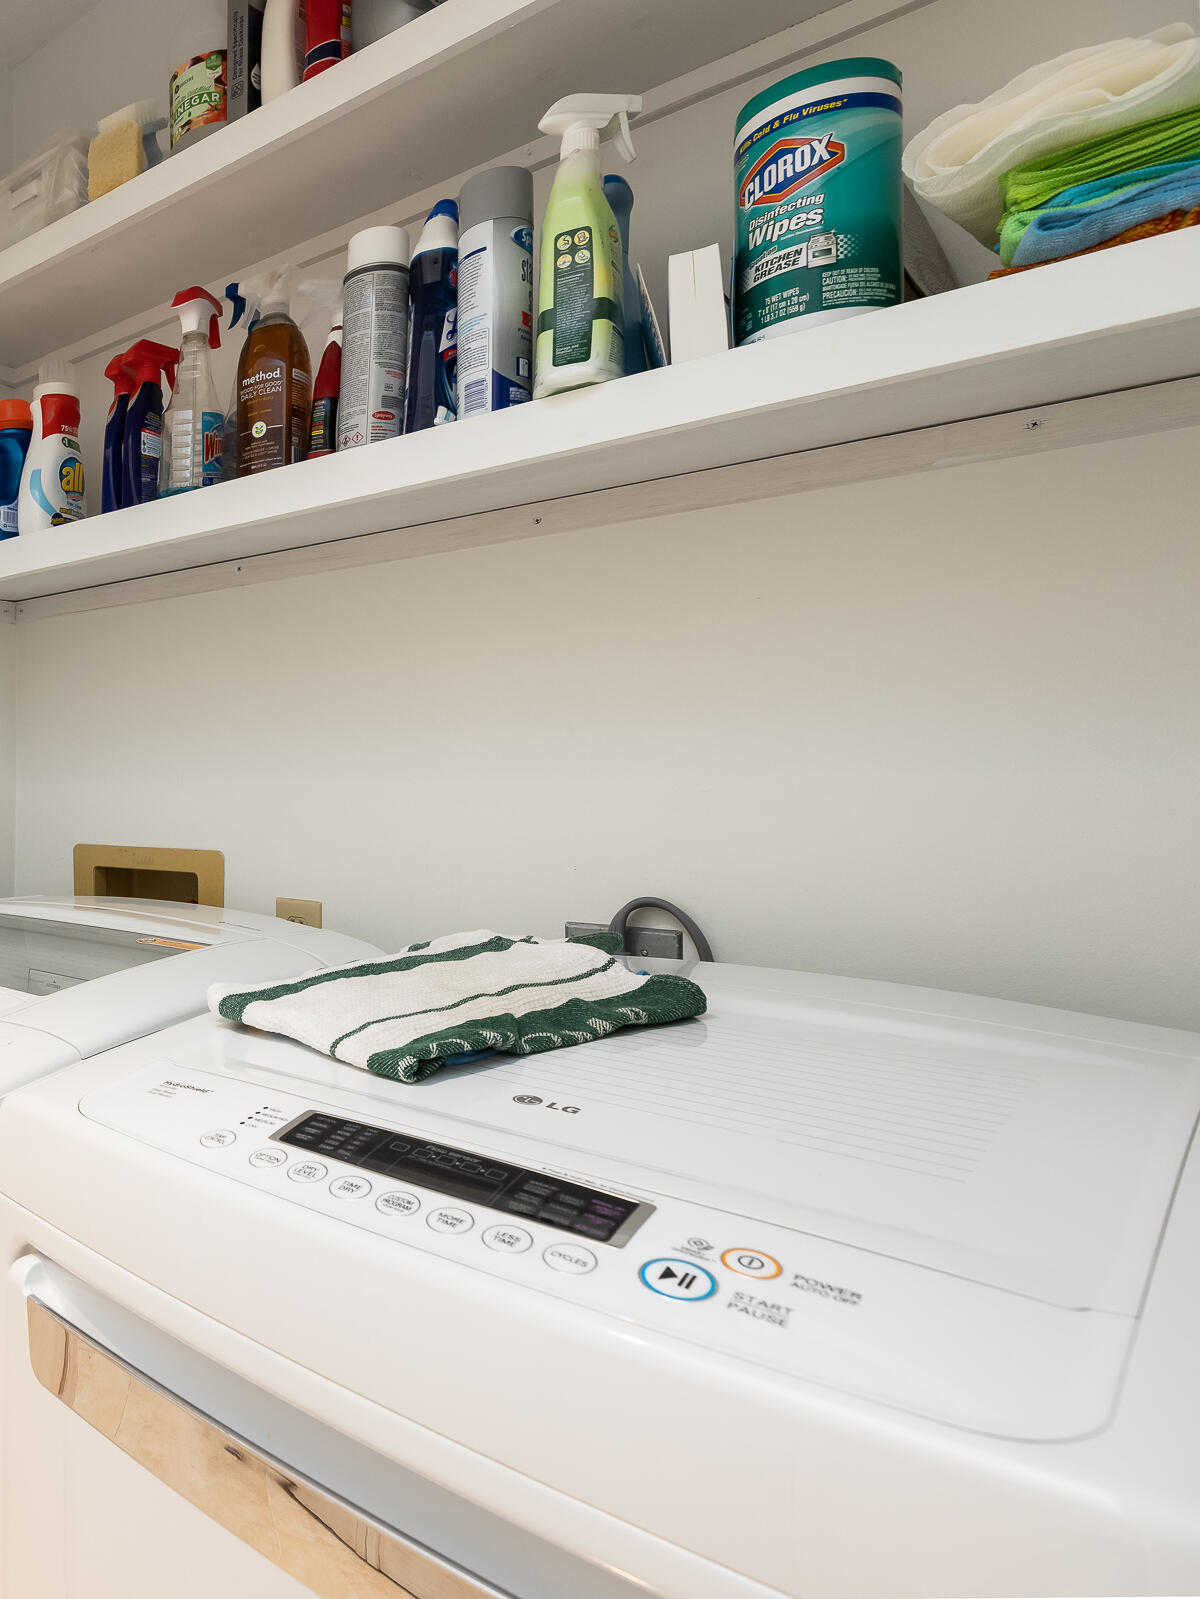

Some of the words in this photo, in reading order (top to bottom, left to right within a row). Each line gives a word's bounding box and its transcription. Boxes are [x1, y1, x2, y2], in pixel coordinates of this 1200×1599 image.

[174, 92, 220, 120] INEGAR
[752, 125, 771, 142] Cold
[772, 120, 781, 129] &
[782, 112, 800, 125] Flu
[744, 132, 834, 210] CLOROX
[749, 193, 825, 231] Disinfecting
[748, 208, 824, 251] Wipes
[753, 256, 801, 283] GREASE
[754, 247, 803, 275] KITCHEN
[771, 293, 782, 303] WET
[782, 287, 800, 299] WIPES
[242, 367, 281, 387] method
[254, 382, 265, 390] FOR
[264, 380, 282, 388] GOOD
[240, 390, 257, 402] DAILY
[258, 386, 282, 396] CLEAN
[203, 431, 223, 464] Win
[61, 462, 84, 493] all
[545, 1101, 582, 1115] LG
[293, 1168, 318, 1179] LEVEL
[301, 1164, 320, 1173] DRY
[337, 1185, 358, 1194] DRY
[343, 1180, 363, 1190] TIME
[383, 1198, 413, 1212] PROGRAM
[387, 1194, 415, 1206] CUSTOM
[437, 1216, 458, 1229] TIME
[438, 1211, 466, 1224] MORE
[493, 1235, 518, 1248] TIME
[496, 1230, 522, 1243] LESS
[549, 1250, 589, 1269] CYCLES
[790, 1281, 831, 1300] AUTO
[793, 1273, 863, 1301] POWER
[732, 1291, 796, 1315] START
[726, 1301, 789, 1329] PAUSE
